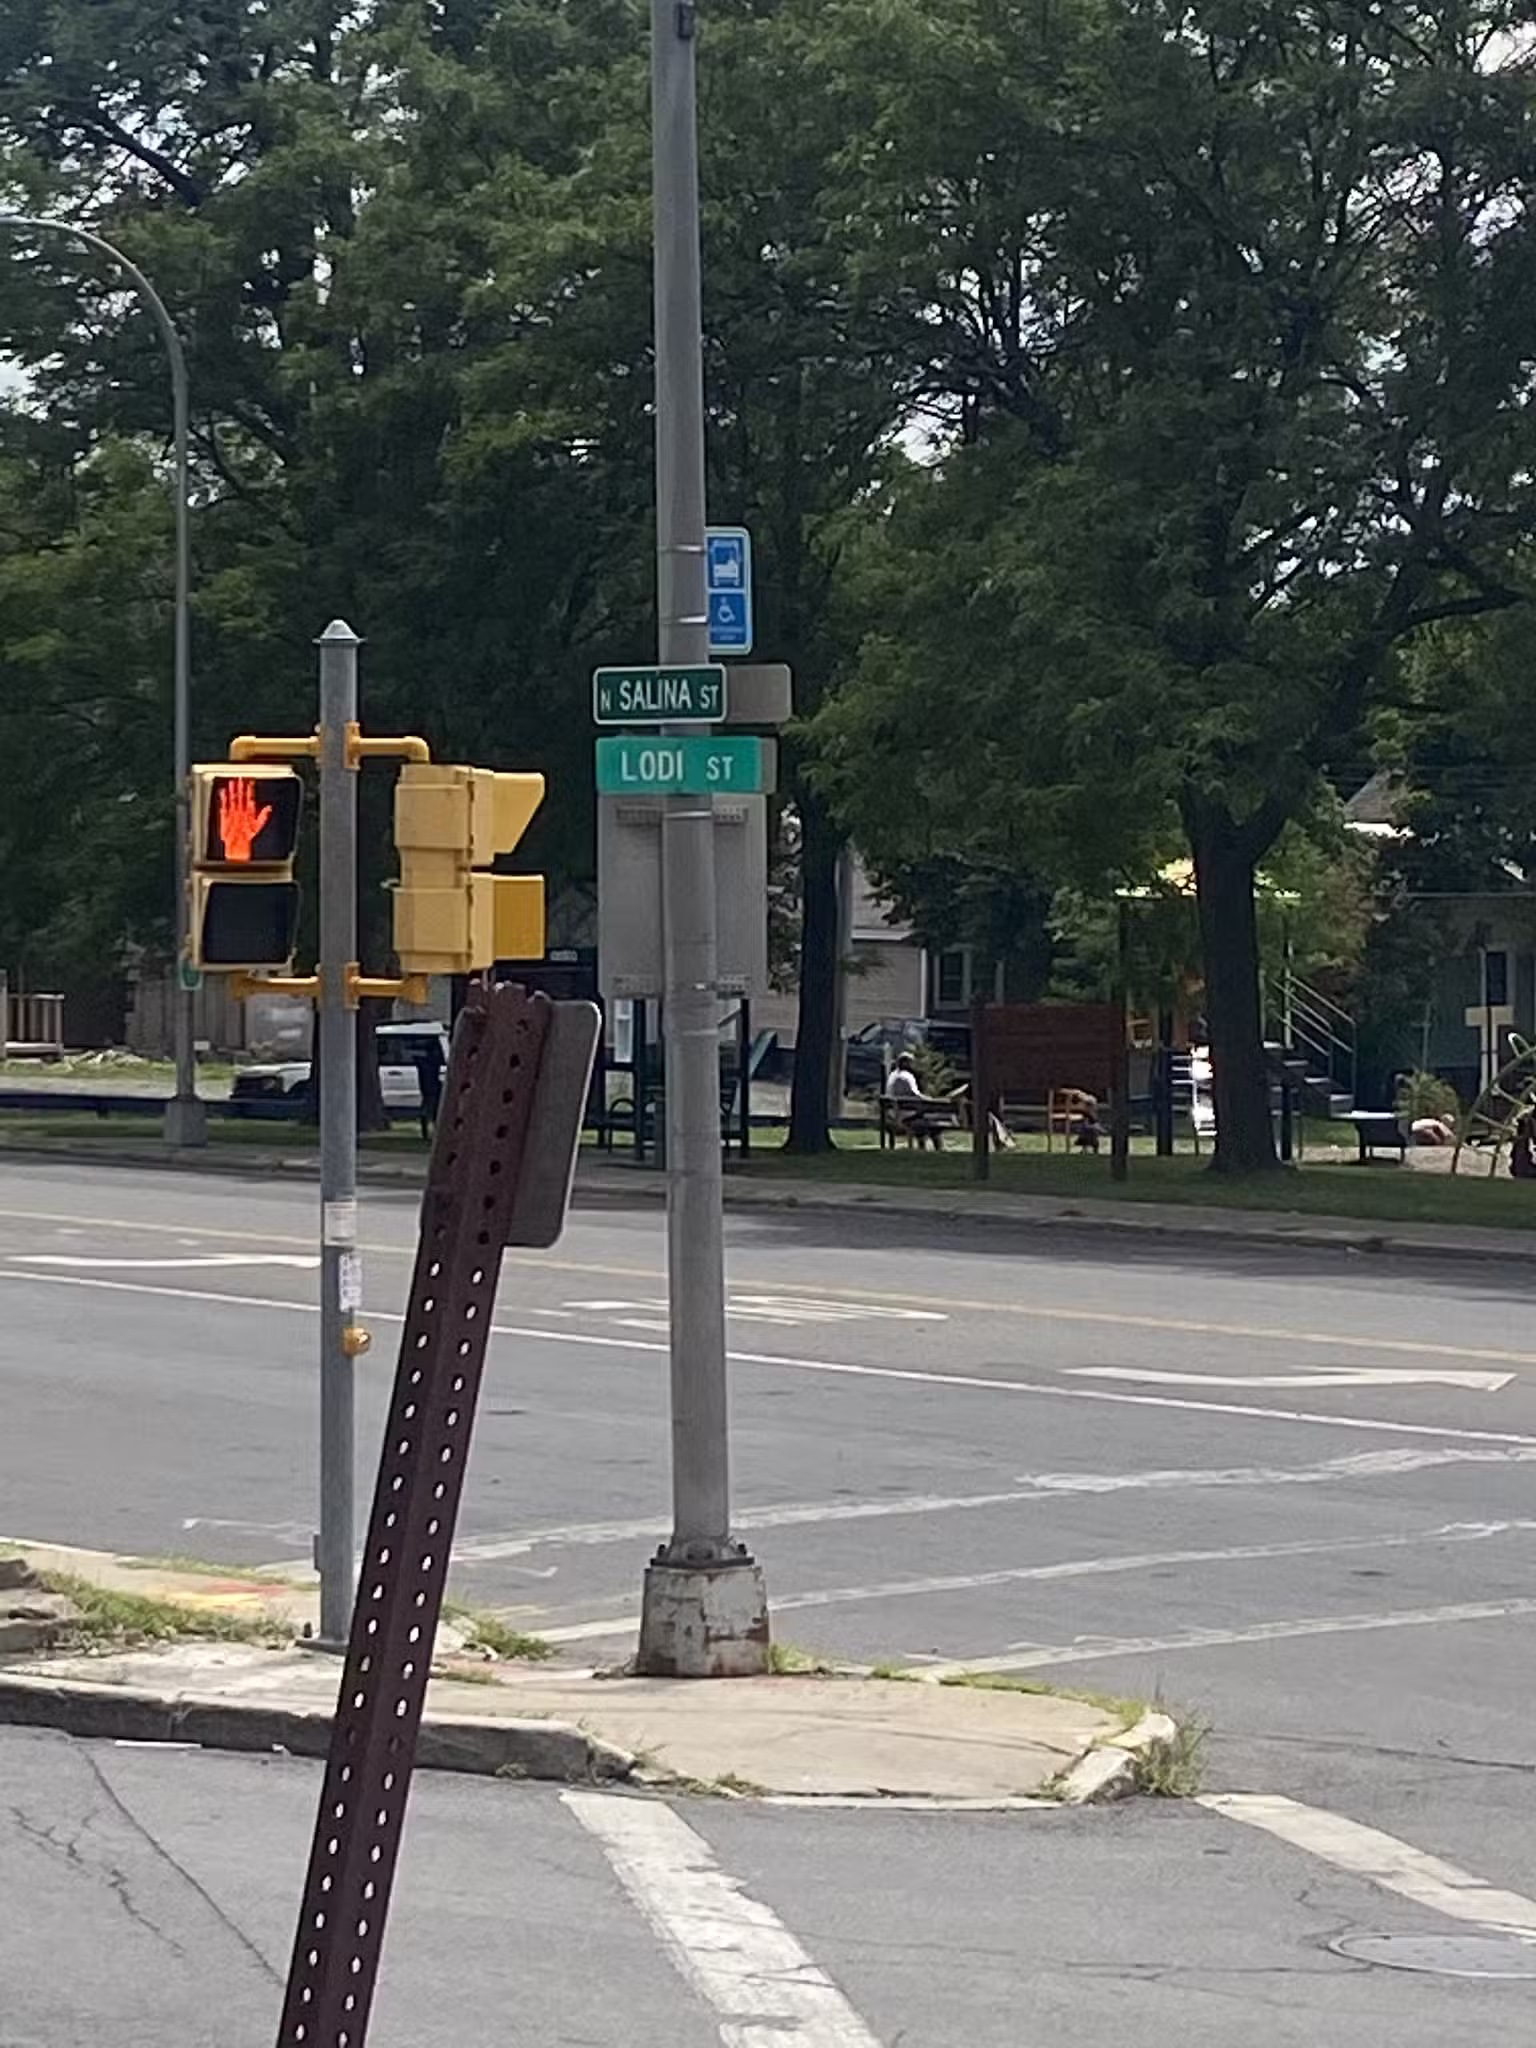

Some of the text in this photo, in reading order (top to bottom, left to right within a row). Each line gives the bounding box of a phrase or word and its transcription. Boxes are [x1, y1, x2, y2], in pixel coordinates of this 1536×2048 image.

[601, 679, 719, 711] N SALINA ST
[621, 750, 733, 782] LODI ST
